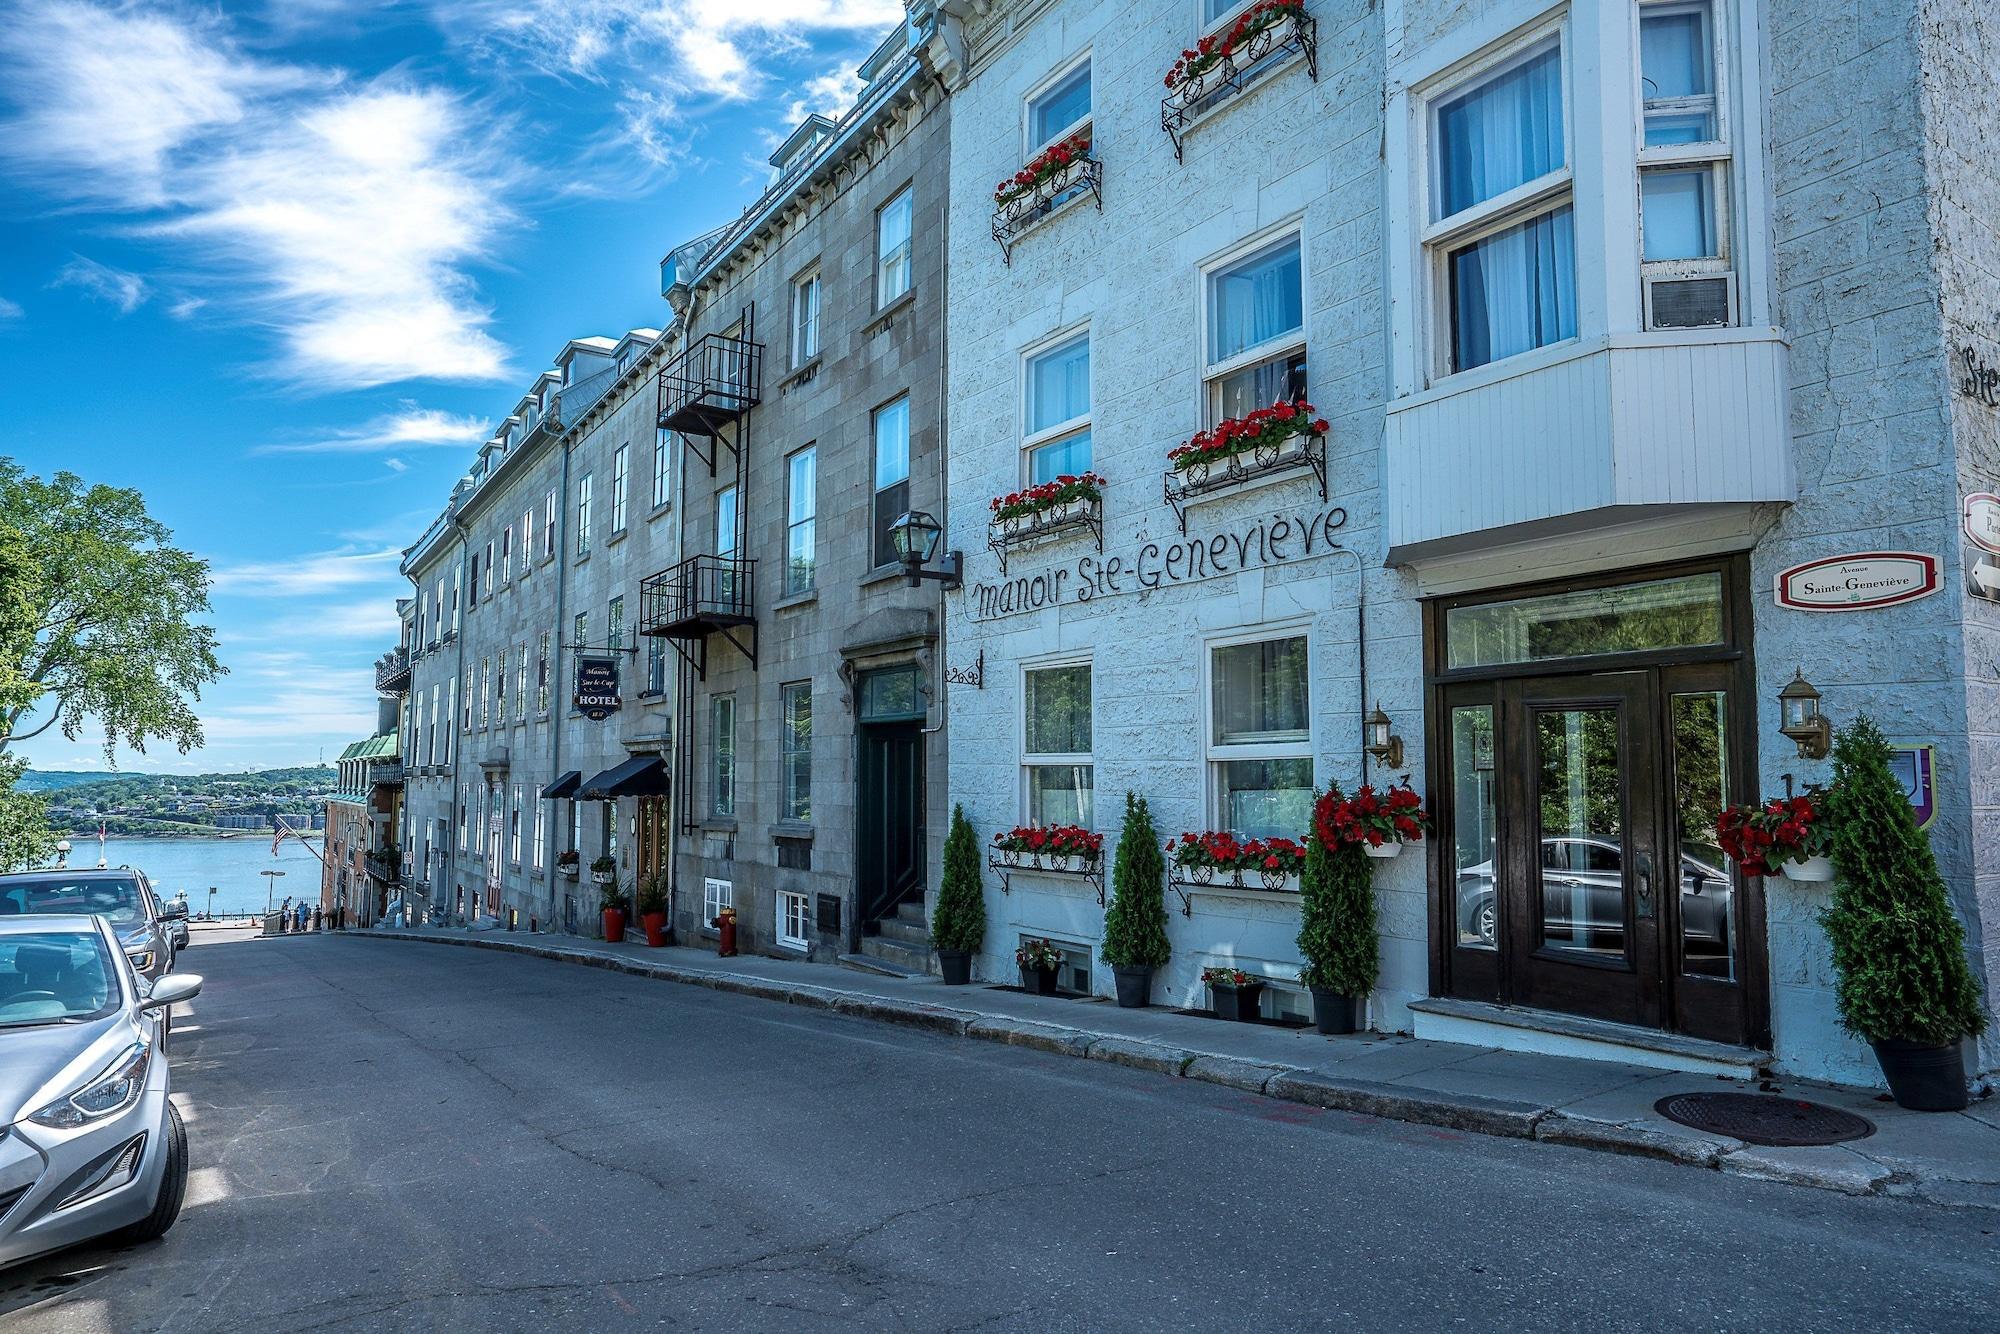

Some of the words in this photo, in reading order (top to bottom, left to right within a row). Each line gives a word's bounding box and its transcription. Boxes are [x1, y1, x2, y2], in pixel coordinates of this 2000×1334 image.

[1078, 507, 1347, 602] Ste-Geneviève
[1840, 566, 1869, 574] Avenue
[1804, 577, 1910, 595] Sainte-Geneviève
[579, 696, 619, 705] HOTEL
